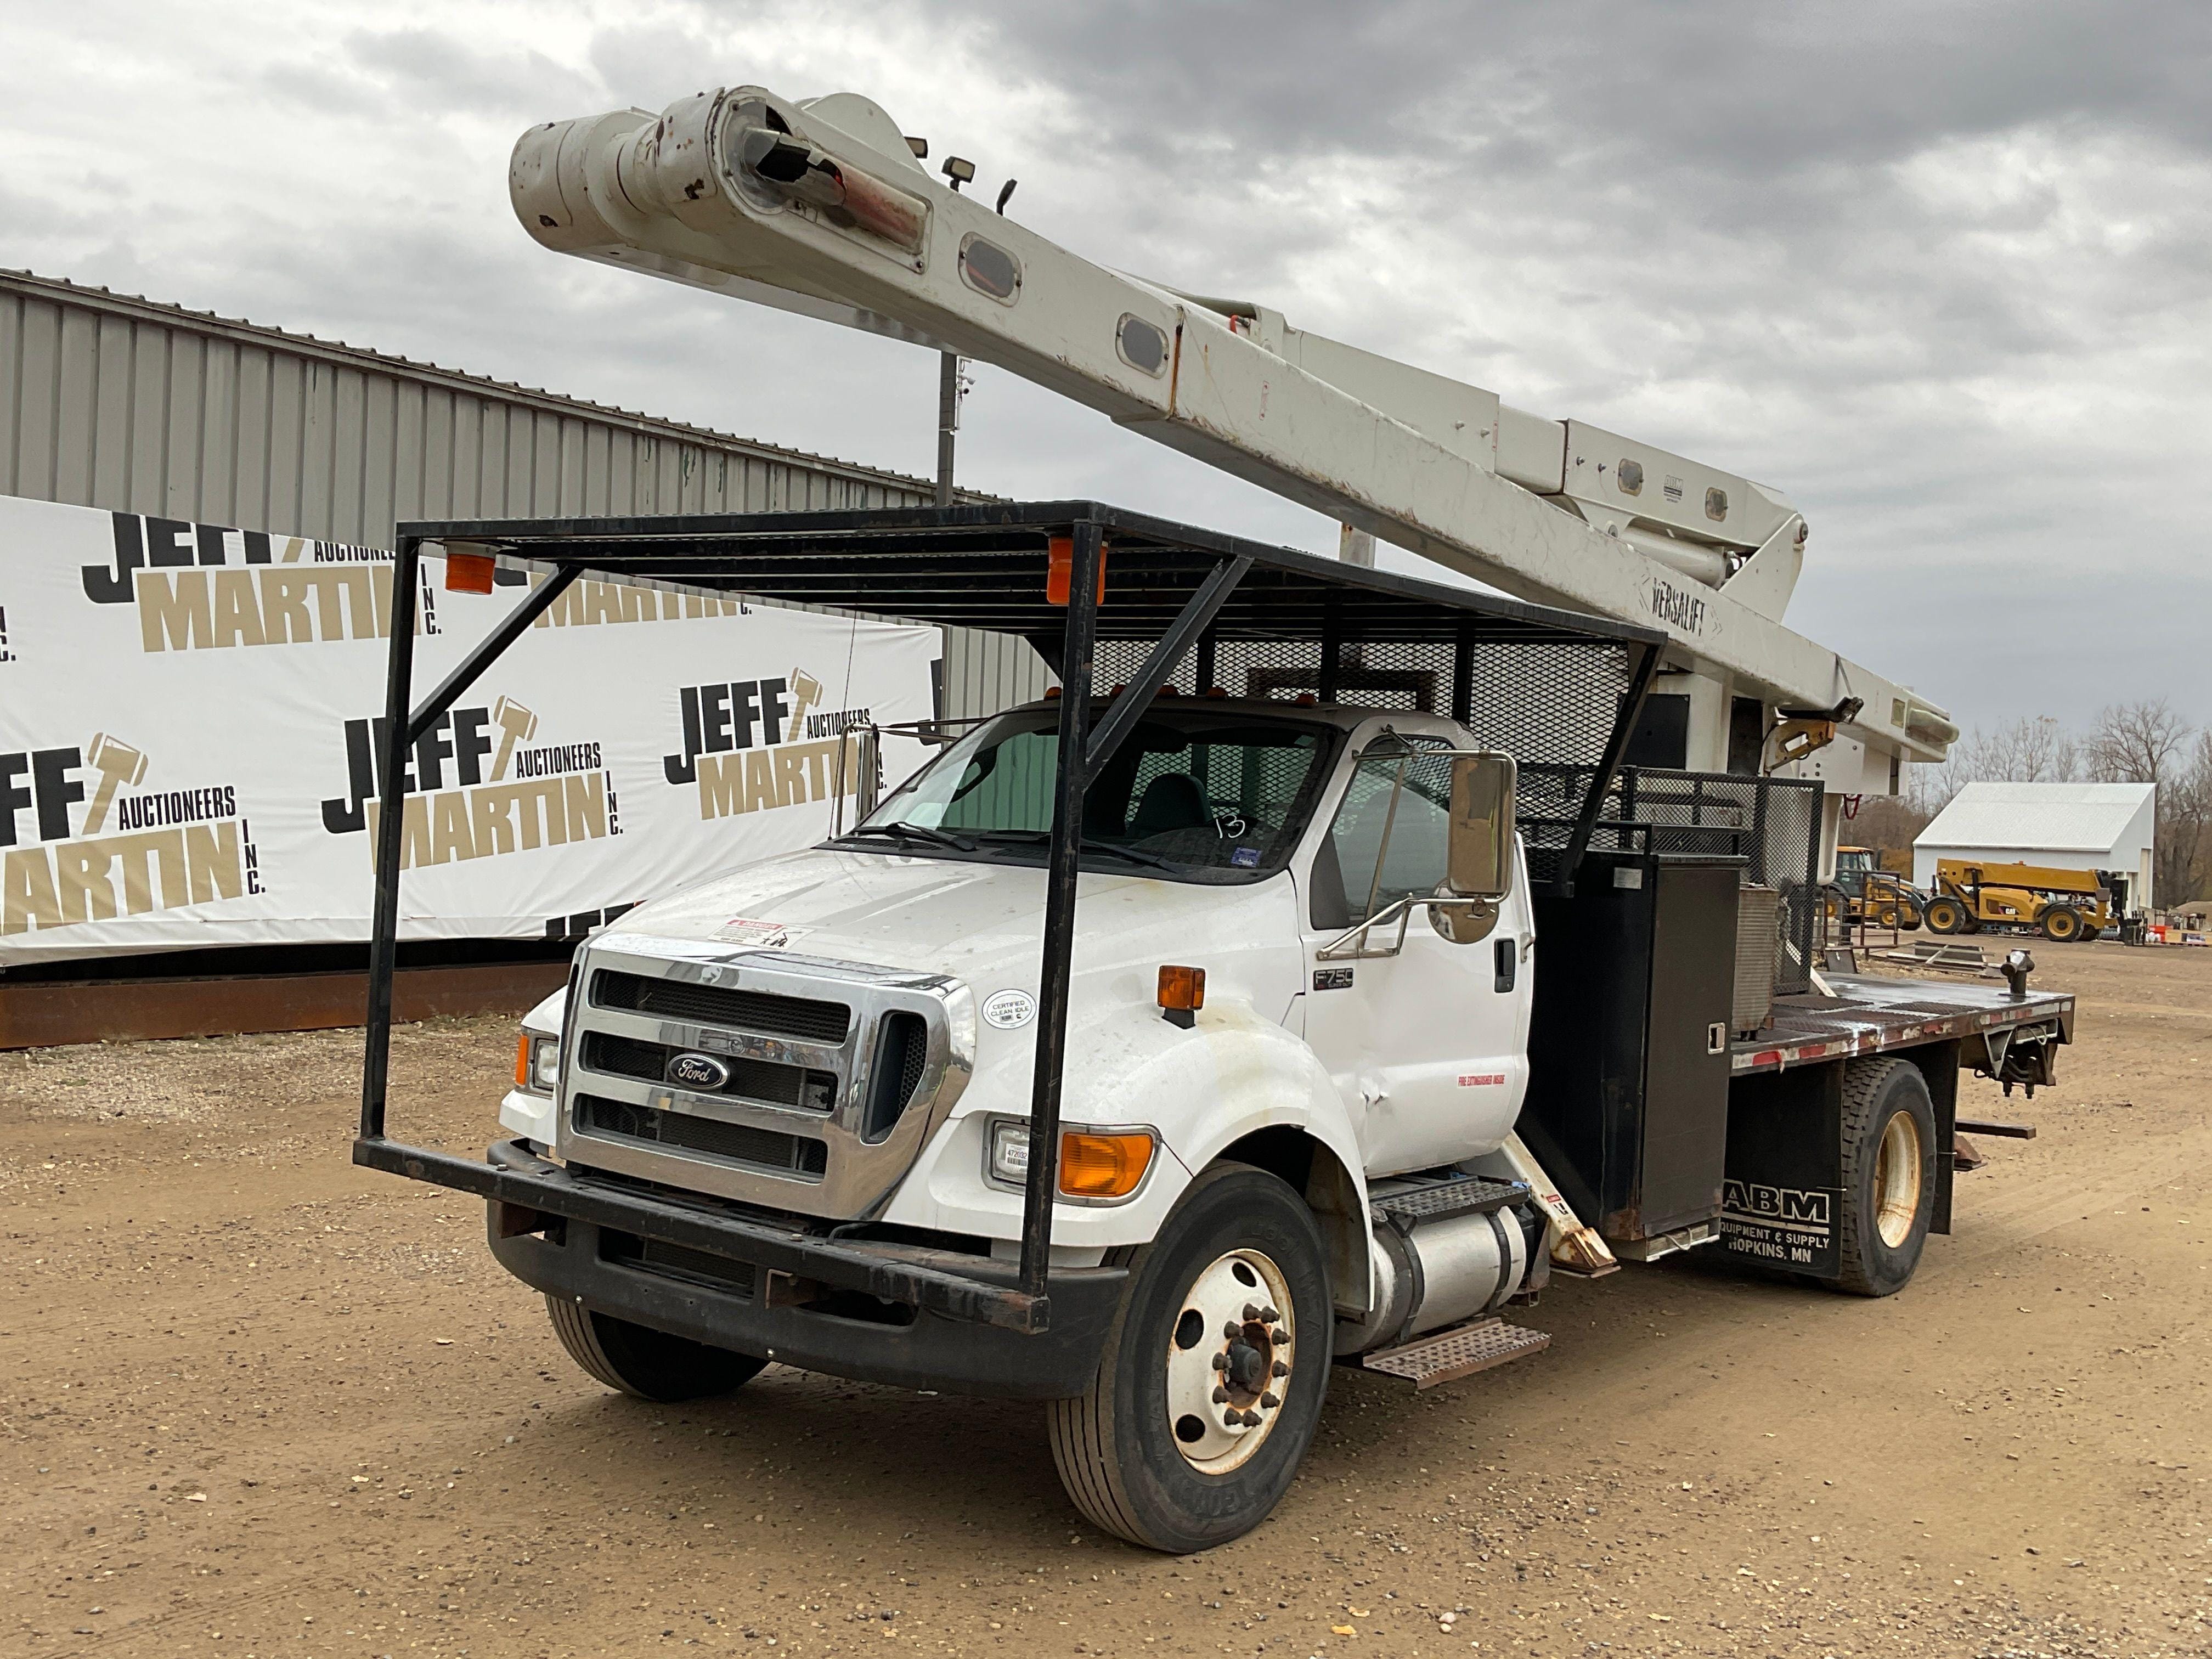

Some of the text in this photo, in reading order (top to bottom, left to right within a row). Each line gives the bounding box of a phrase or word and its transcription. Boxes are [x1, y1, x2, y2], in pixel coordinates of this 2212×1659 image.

[421, 563, 442, 635] INC.
[1652, 577, 1705, 637] VERSALIFT
[664, 677, 789, 785] JEFF
[516, 742, 601, 778] AUCTIONEERS
[697, 737, 858, 820] MARTI
[119, 786, 236, 830] AUCTIONEERS
[606, 770, 623, 836] INC.
[1216, 813, 1245, 839] 13
[0, 821, 242, 936] ARTIN
[242, 819, 266, 895] INC.
[992, 1000, 1025, 1009] CERTIFIED
[678, 1059, 712, 1082] Ford
[1722, 1178, 1830, 1223] ABM
[1720, 1221, 1770, 1240] QUIPMENT
[1786, 1233, 1830, 1249] SUPPLY
[1791, 1247, 1812, 1262] MN
